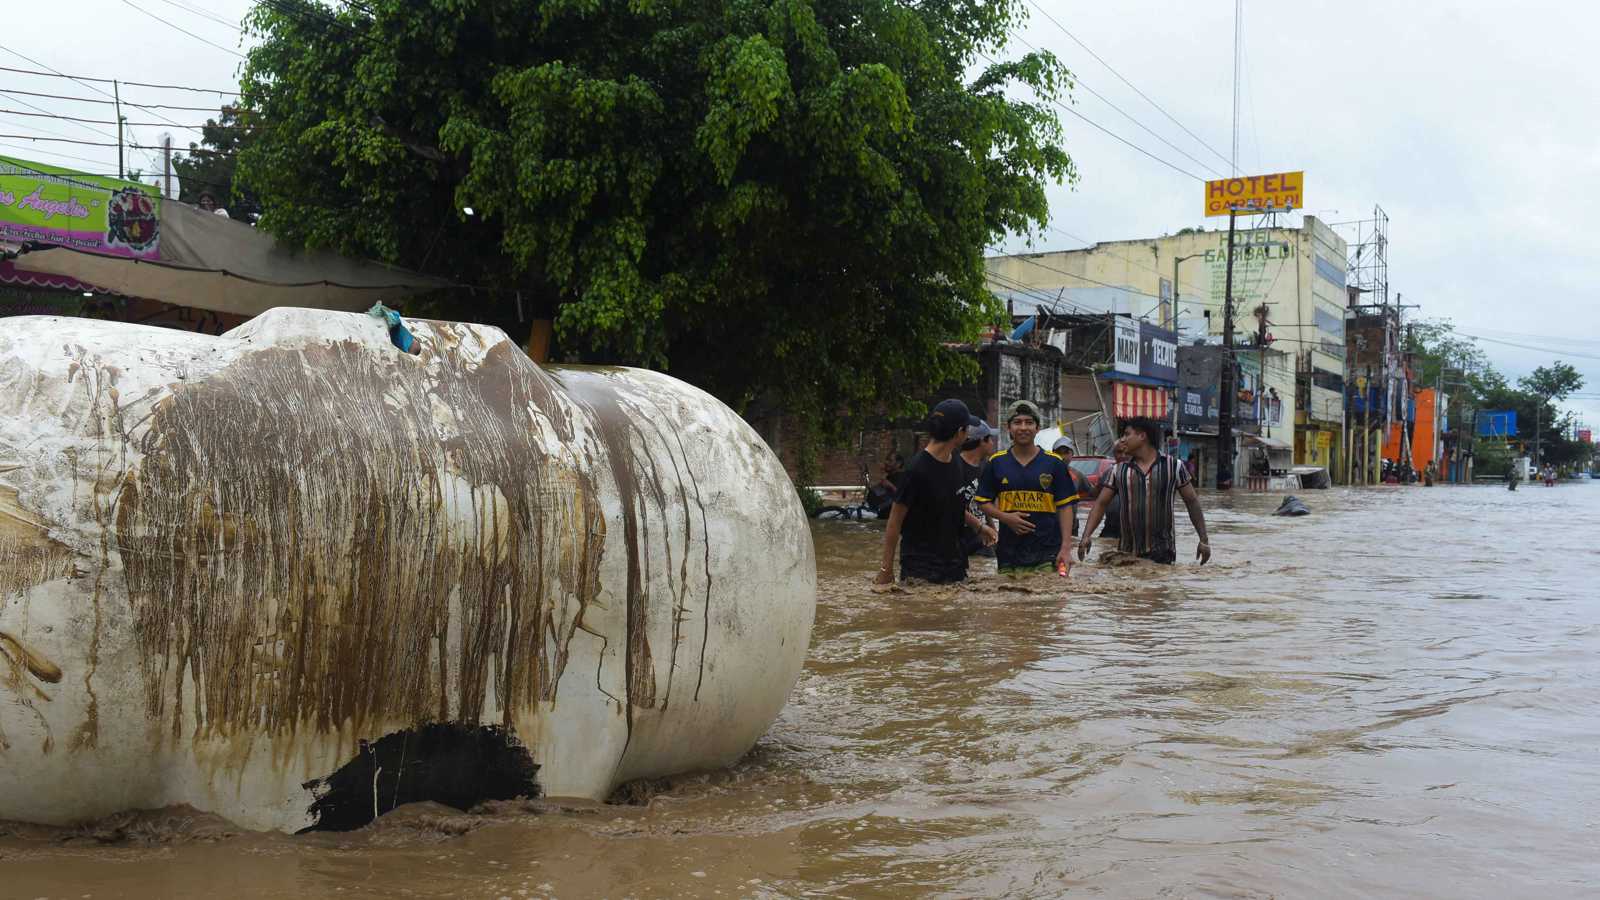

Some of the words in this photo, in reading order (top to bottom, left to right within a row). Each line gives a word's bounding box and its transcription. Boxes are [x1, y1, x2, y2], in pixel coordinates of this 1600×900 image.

[1209, 173, 1297, 199] HOTEL
[1209, 192, 1299, 212] GARBLDI
[1117, 336, 1138, 365] MARY
[1152, 338, 1177, 368] TECATE
